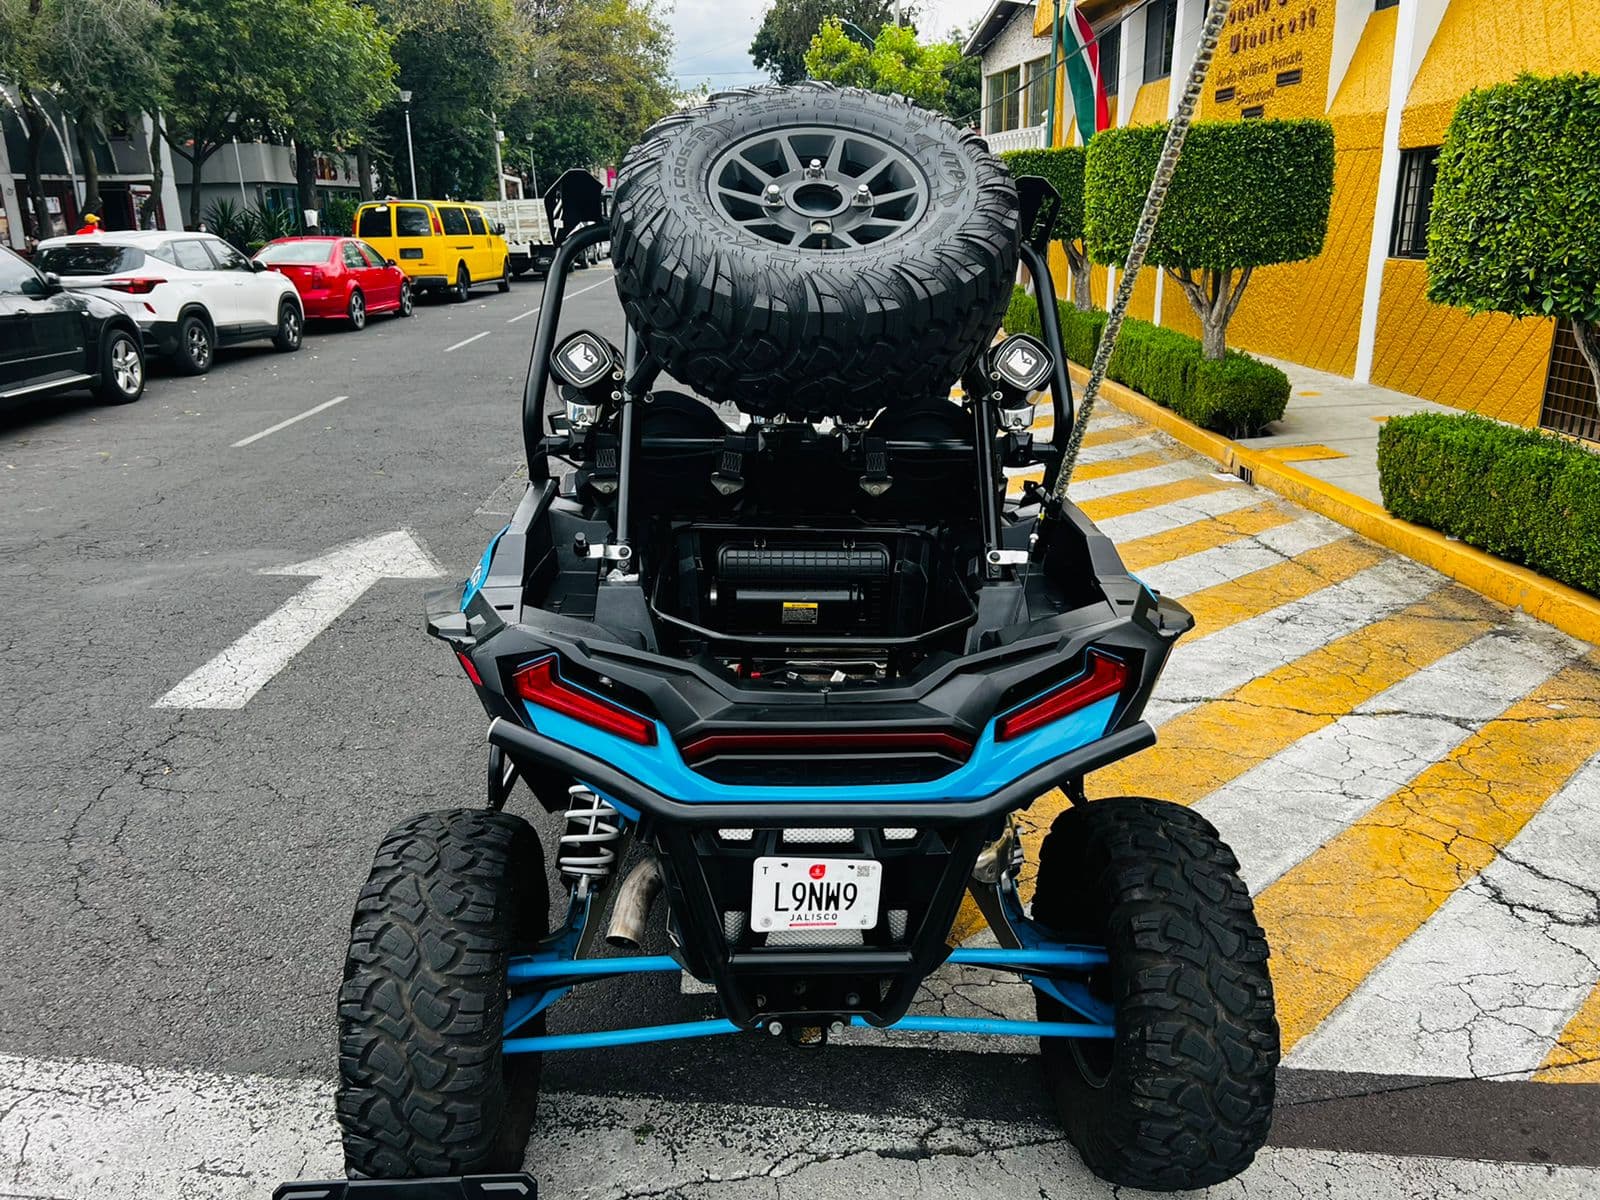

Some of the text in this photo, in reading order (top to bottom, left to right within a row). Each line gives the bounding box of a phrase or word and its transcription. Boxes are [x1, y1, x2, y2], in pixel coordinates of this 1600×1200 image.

[674, 139, 699, 189] CROSS
[940, 151, 967, 180] ITP
[762, 866, 769, 875] T
[774, 882, 858, 912] L9NW9
[789, 913, 838, 922] JALISCO
